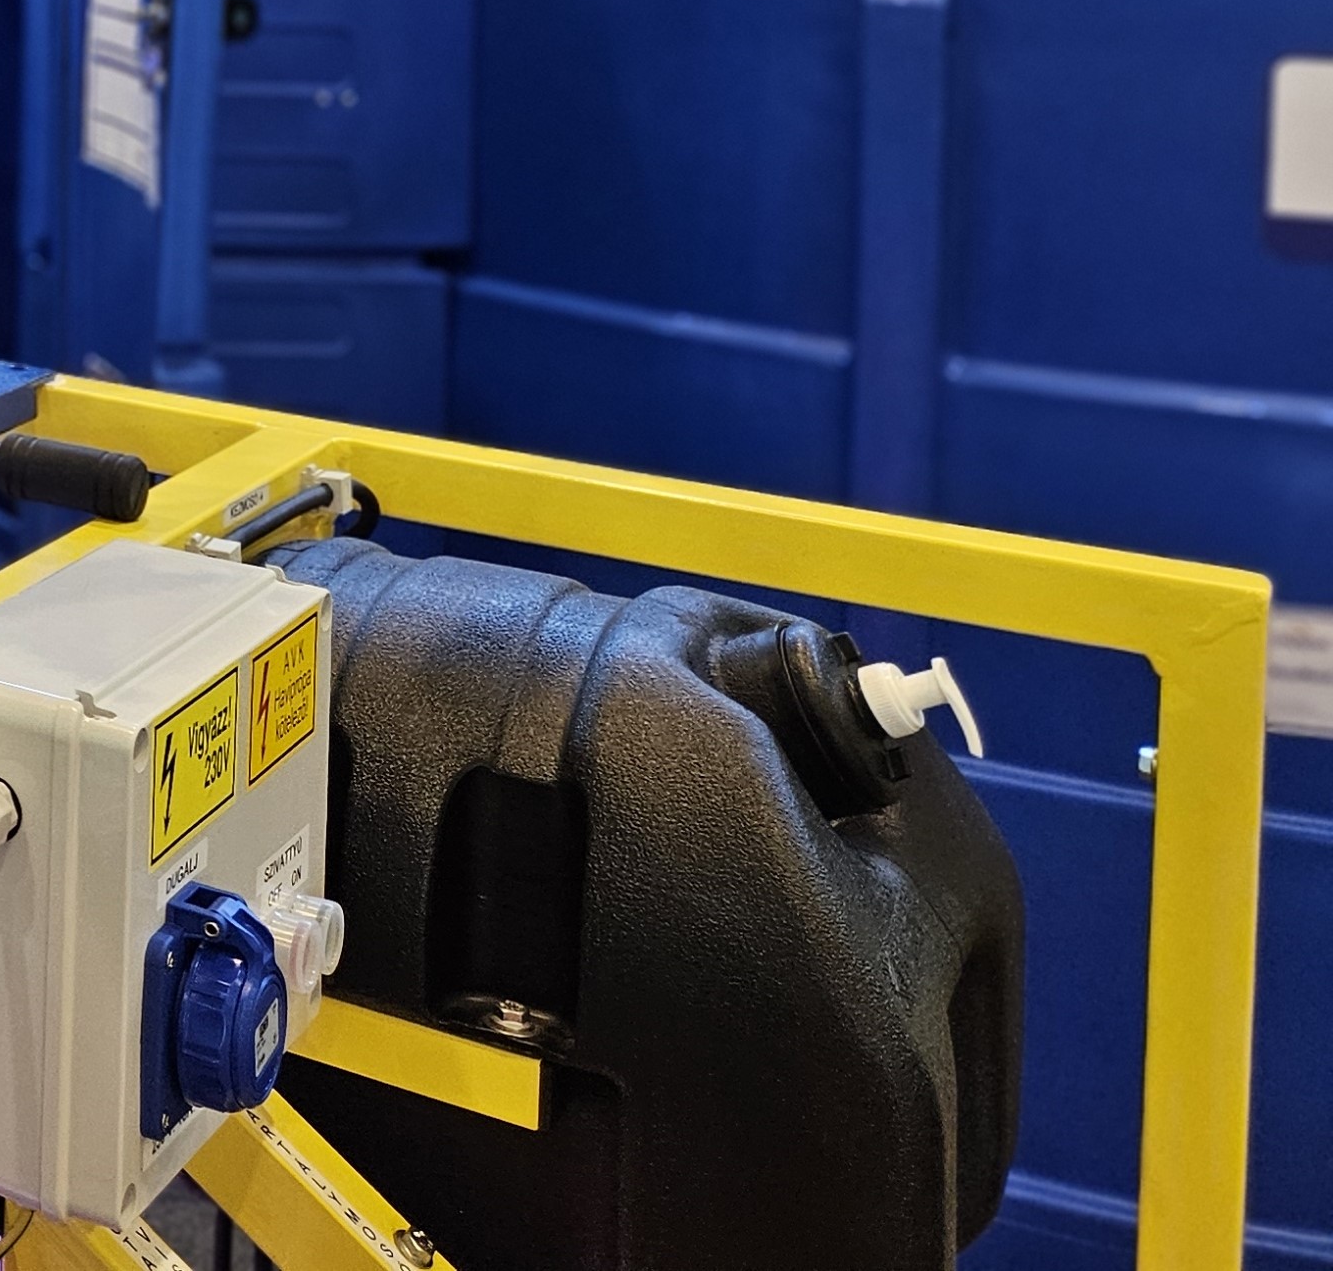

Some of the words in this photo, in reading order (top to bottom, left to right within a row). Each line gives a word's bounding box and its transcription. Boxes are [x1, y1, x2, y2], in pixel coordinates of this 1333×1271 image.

[188, 696, 232, 760] Vigyázz!
[204, 737, 231, 788] 230V
[166, 851, 199, 895] DUGALJ
[291, 865, 302, 886] ON
